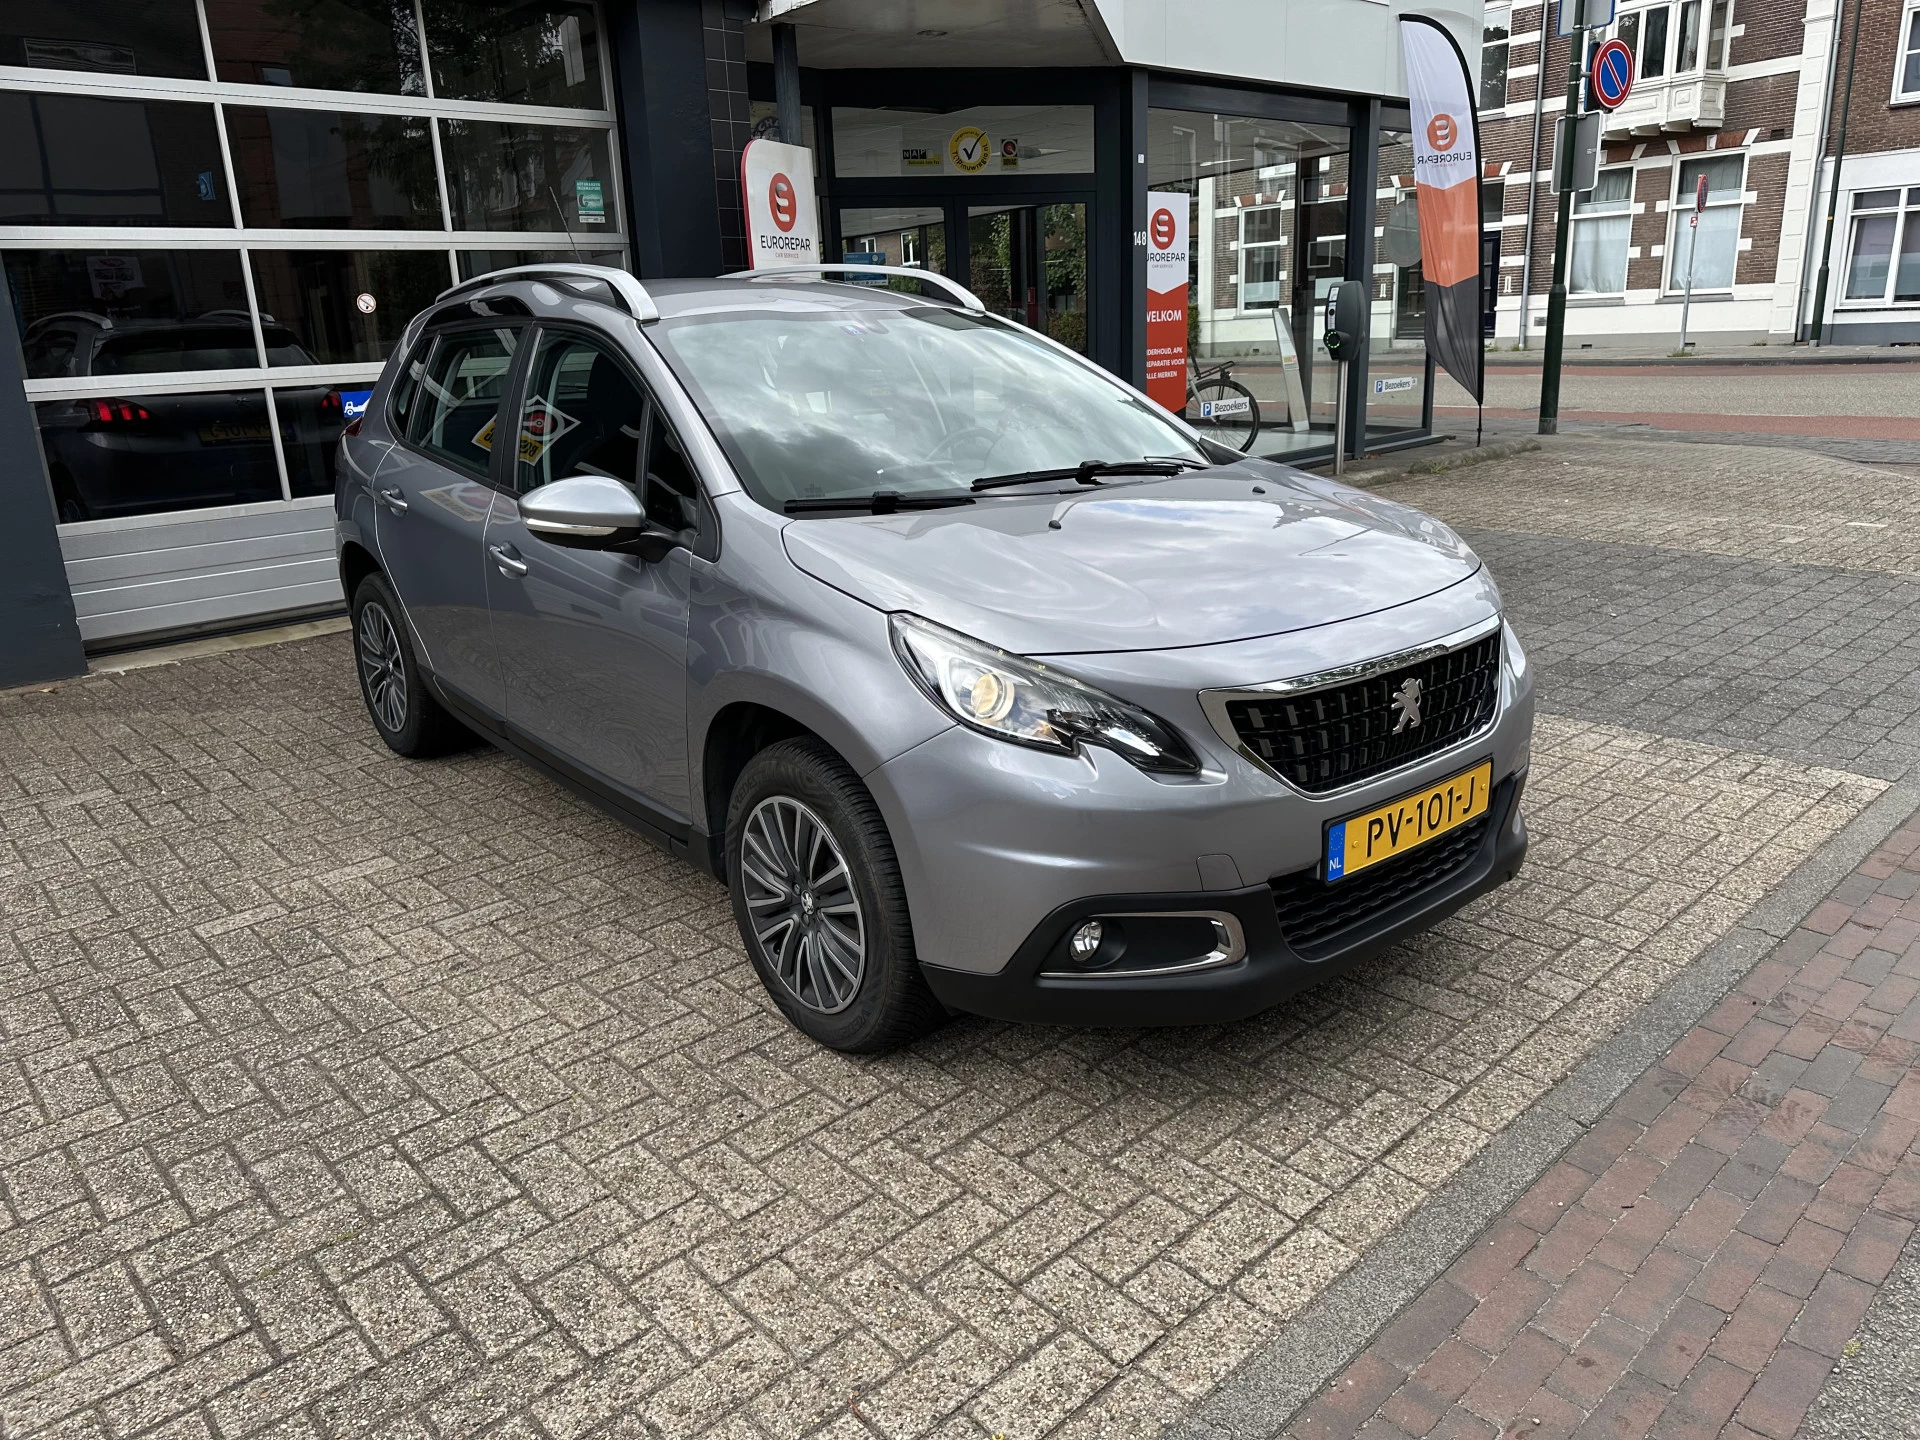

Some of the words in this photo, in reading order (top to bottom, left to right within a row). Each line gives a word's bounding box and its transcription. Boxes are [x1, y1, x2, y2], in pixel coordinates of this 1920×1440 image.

[903, 149, 927, 159] NAP
[760, 235, 811, 251] EUROREPAR
[1133, 231, 1147, 246] 148
[1171, 358, 1185, 366] VOOR
[1158, 370, 1178, 379] MERKEN
[1384, 379, 1411, 390] Bezoekers
[1214, 400, 1248, 413] Bezoekers
[1366, 776, 1475, 858] PV-101-J
[1330, 857, 1342, 871] NL
